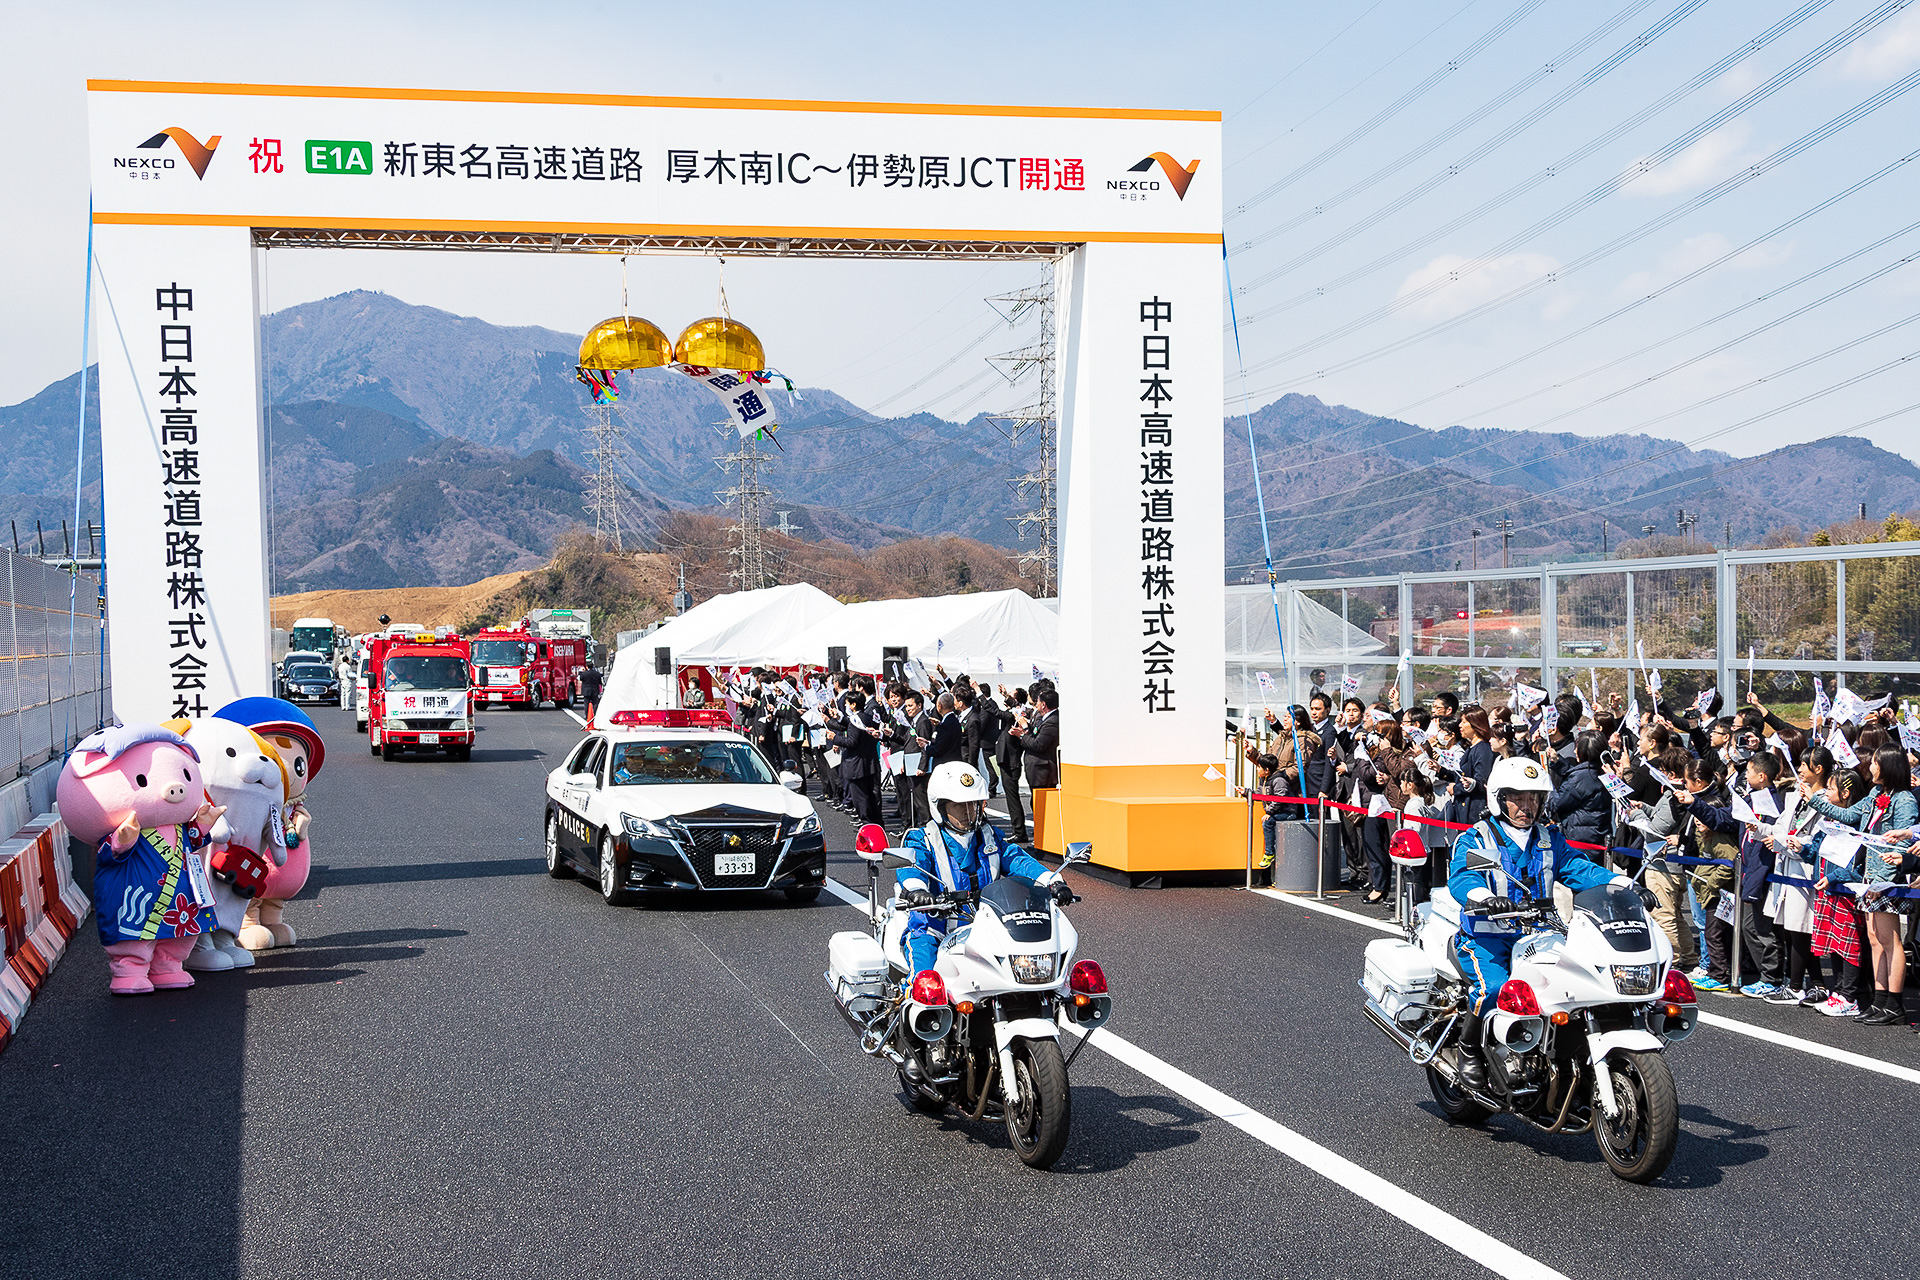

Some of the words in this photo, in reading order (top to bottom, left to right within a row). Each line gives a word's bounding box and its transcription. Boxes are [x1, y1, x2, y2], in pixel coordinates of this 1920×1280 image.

[113, 158, 175, 169] NEXCO
[248, 138, 284, 174] 祝
[310, 146, 367, 171] E1A
[383, 140, 643, 183] 新東名高速道路
[129, 171, 161, 181] 中日本
[1106, 180, 1161, 191] NEXCO
[1119, 193, 1149, 202] 中日本
[1139, 295, 1176, 714] 中日本高速道路株式会社
[403, 696, 416, 708] 祝
[423, 696, 449, 708] 開通
[558, 808, 586, 841] POLICE
[1001, 911, 1050, 923] POLICE
[1600, 920, 1648, 933] POLICE
